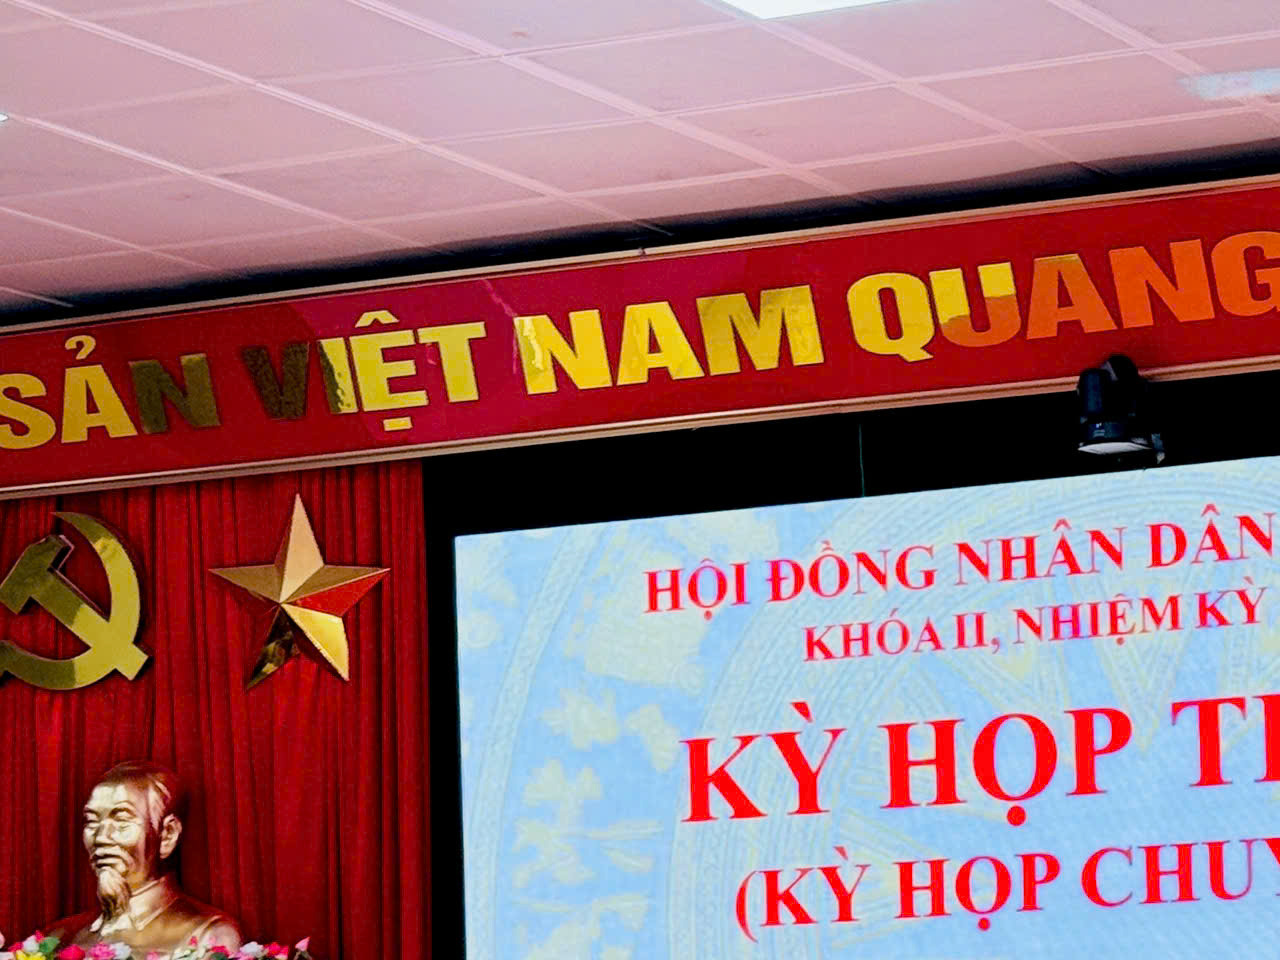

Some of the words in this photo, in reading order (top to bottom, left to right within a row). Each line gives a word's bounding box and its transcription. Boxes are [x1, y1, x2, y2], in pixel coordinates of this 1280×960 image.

[0, 334, 221, 449] SẢN
[240, 309, 487, 432] VIỆT
[512, 285, 825, 396] NAM
[646, 563, 748, 620] HỘI
[767, 545, 936, 603] ĐỒNG
[955, 519, 1125, 582] NHÂN
[1148, 503, 1273, 569] DÂN
[804, 607, 944, 661] KHÓA
[954, 611, 1001, 654] II,
[1015, 594, 1181, 645] NHIỆM
[1195, 576, 1268, 629] KỲ
[683, 701, 845, 823] KỲ
[881, 707, 1133, 827] HỌP
[735, 846, 868, 943] (KỲ
[895, 852, 1061, 932] HỌP
